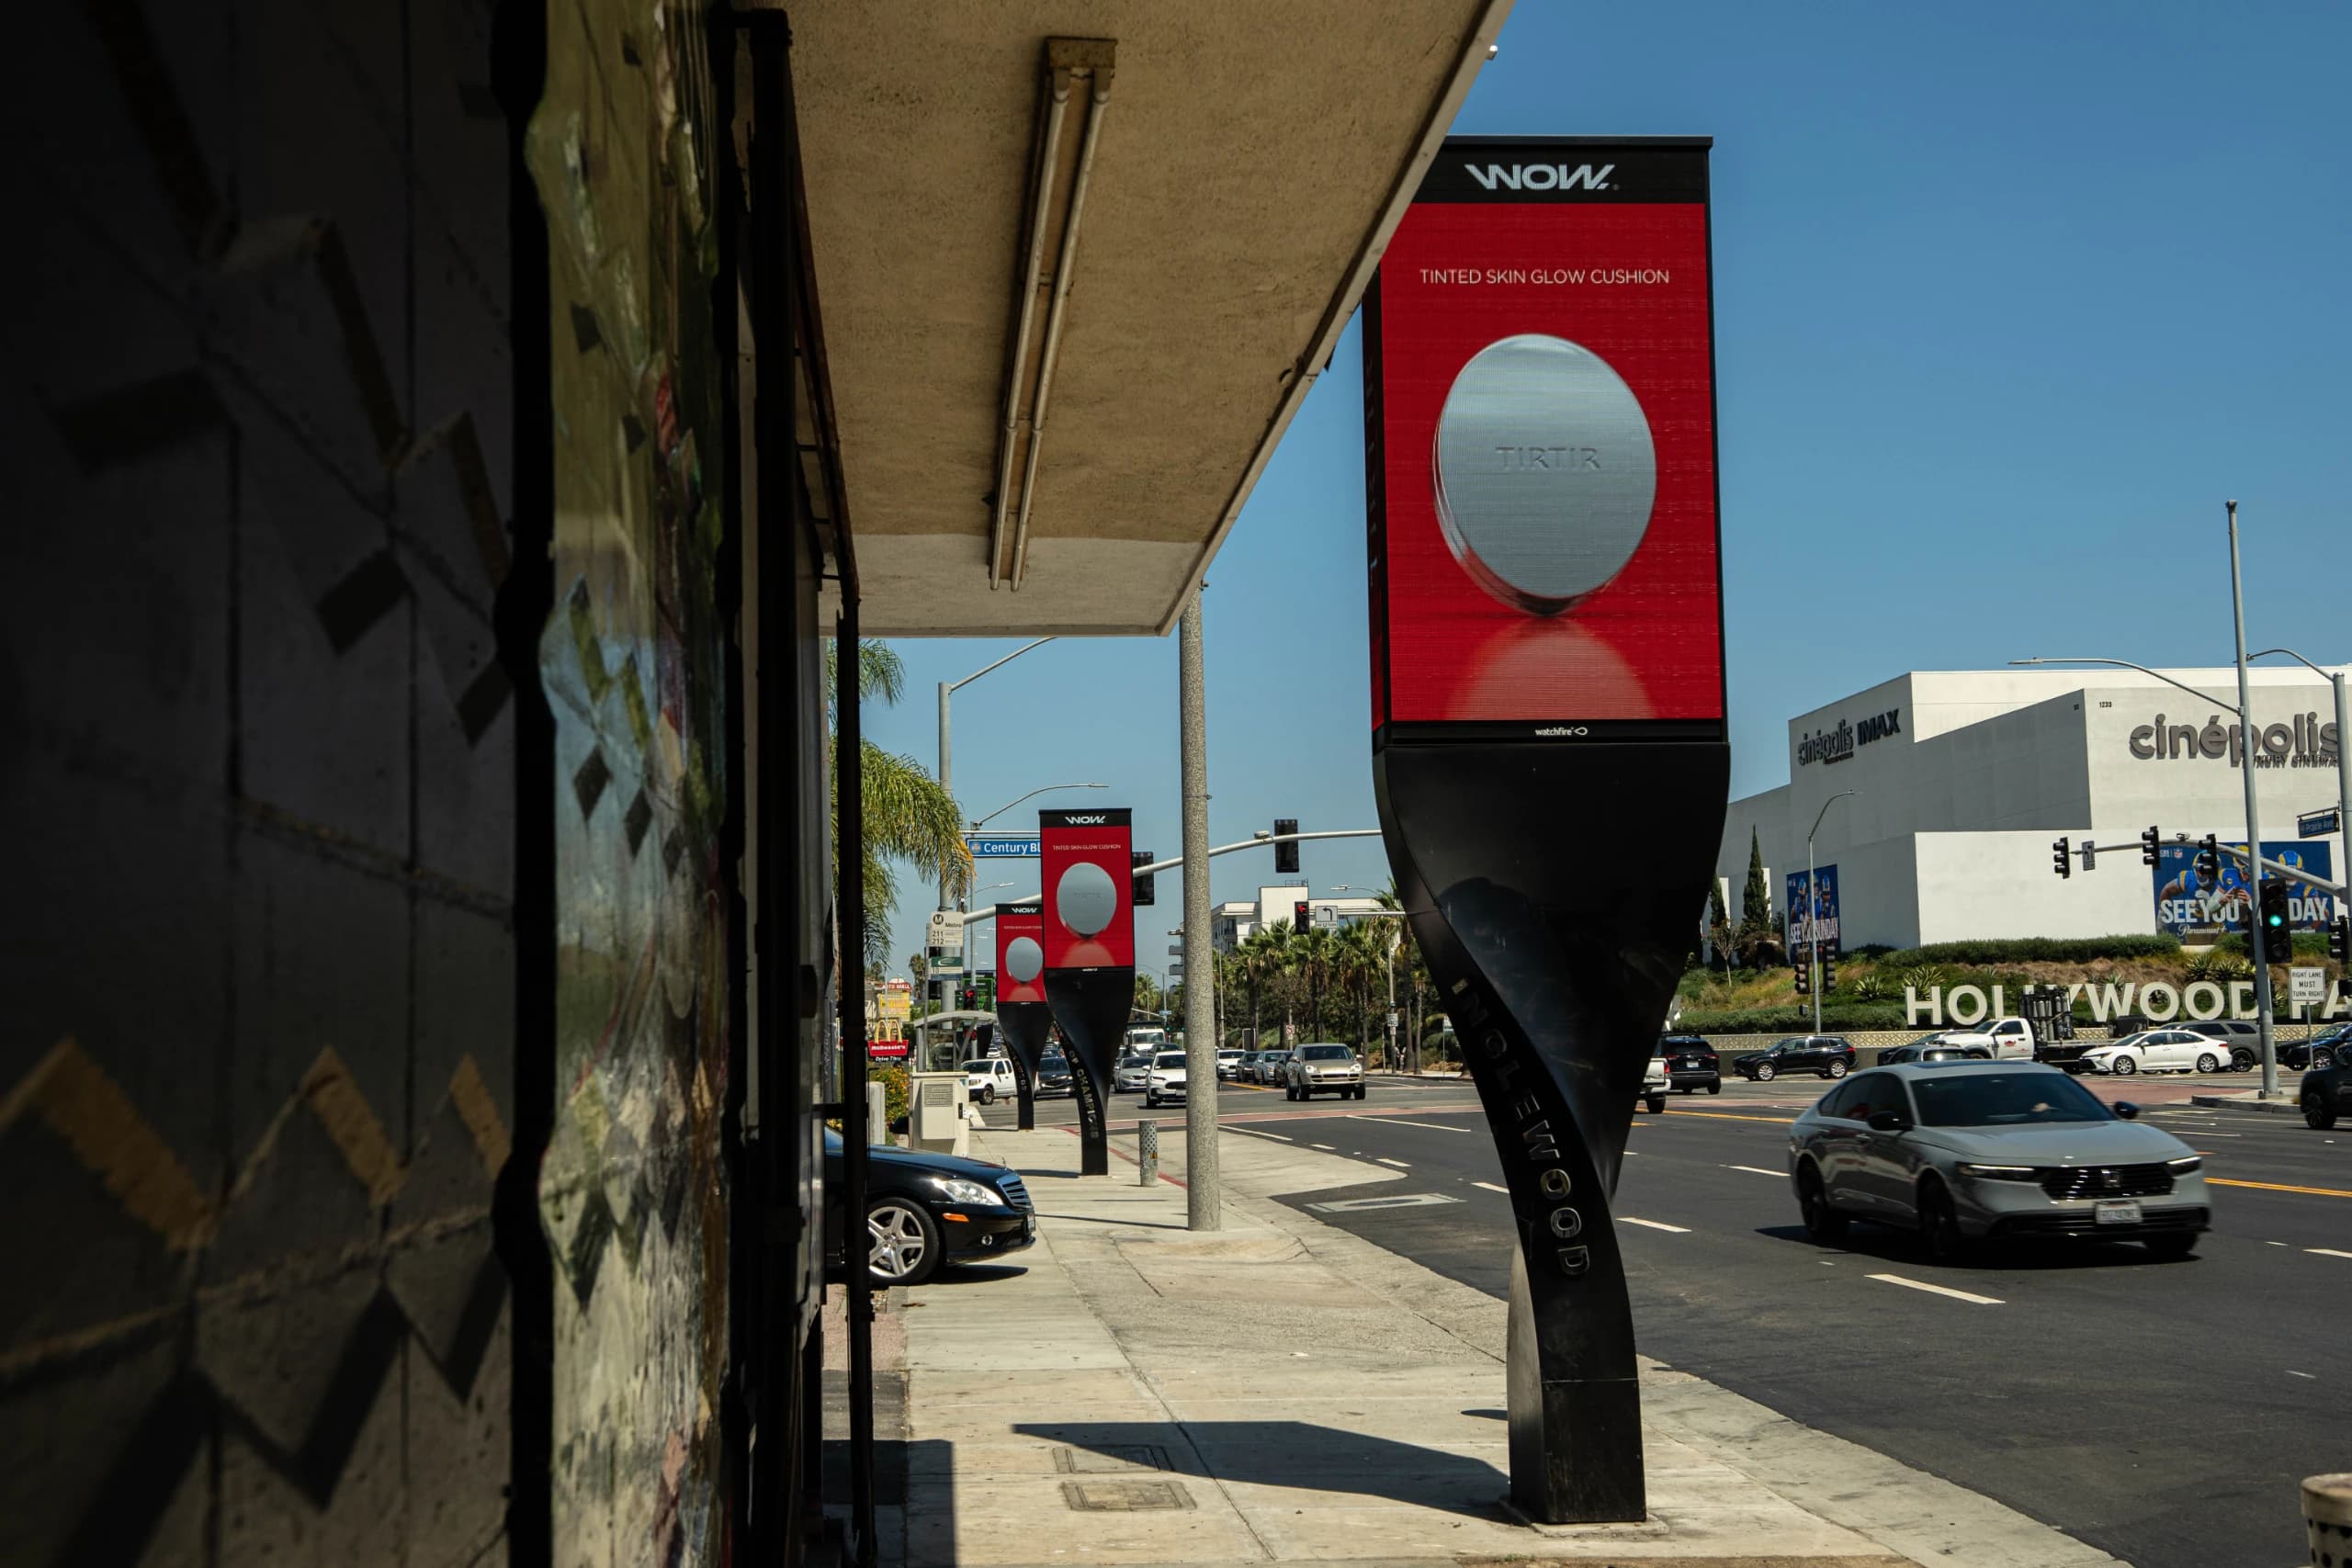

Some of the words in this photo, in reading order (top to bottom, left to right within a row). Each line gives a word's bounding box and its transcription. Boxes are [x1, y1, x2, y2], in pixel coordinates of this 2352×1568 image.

[1419, 269, 1482, 284] TINTED
[1486, 269, 1526, 284] SKIN
[1531, 269, 1586, 285] GLOW
[1590, 269, 1670, 284] CUSHION
[1495, 446, 1601, 471] TIRTIR
[1535, 727, 1572, 736] watchfire
[1857, 708, 1901, 746] IMAX
[984, 842, 1028, 855] Century
[2161, 899, 2196, 923] SEE
[1905, 981, 2260, 1026] HOLWOOD
[1452, 977, 1591, 1276] INGLEWOOD
